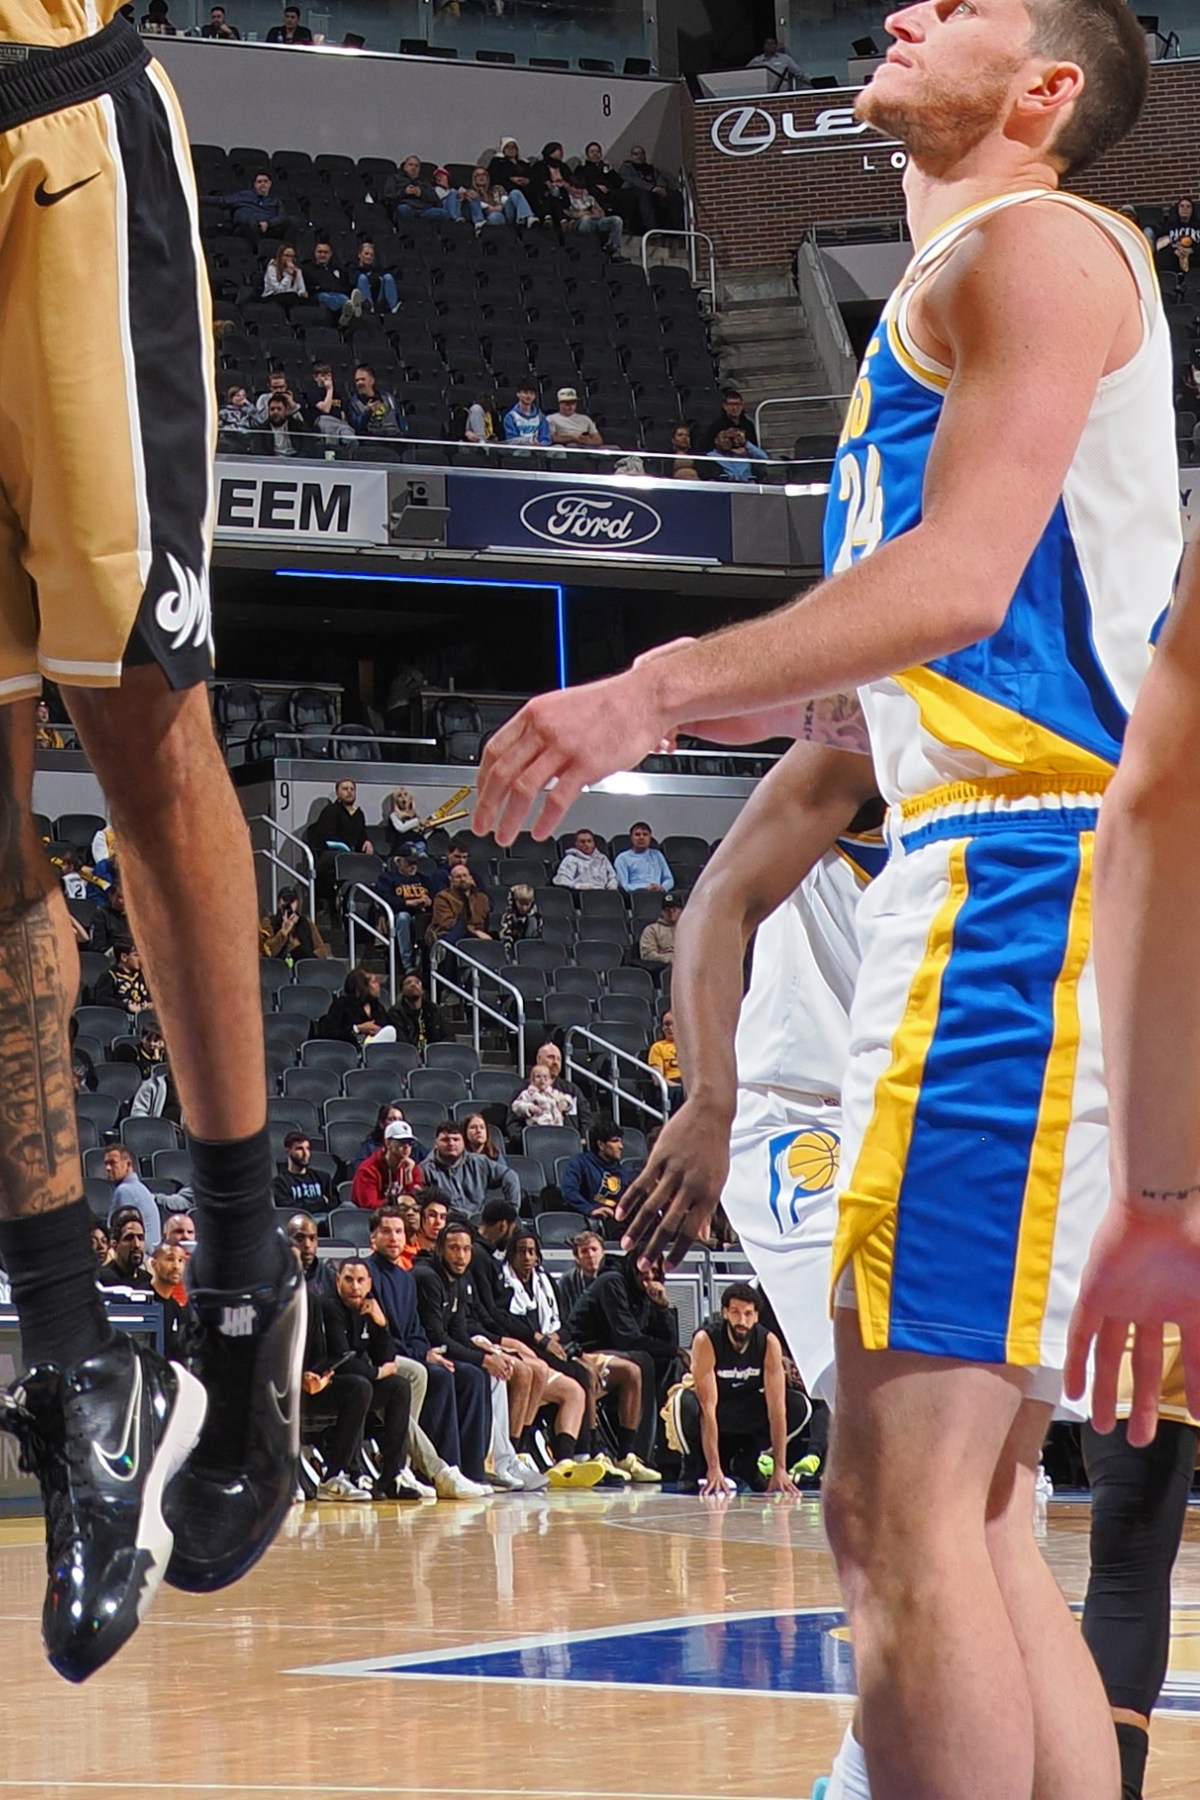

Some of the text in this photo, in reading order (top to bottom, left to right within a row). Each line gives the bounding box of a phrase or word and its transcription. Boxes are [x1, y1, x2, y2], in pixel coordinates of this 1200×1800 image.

[602, 94, 611, 117] 8
[217, 478, 352, 533] EEM
[547, 496, 635, 539] Ford
[831, 443, 884, 576] 24
[280, 781, 290, 811] 9
[74, 883, 83, 897] 2
